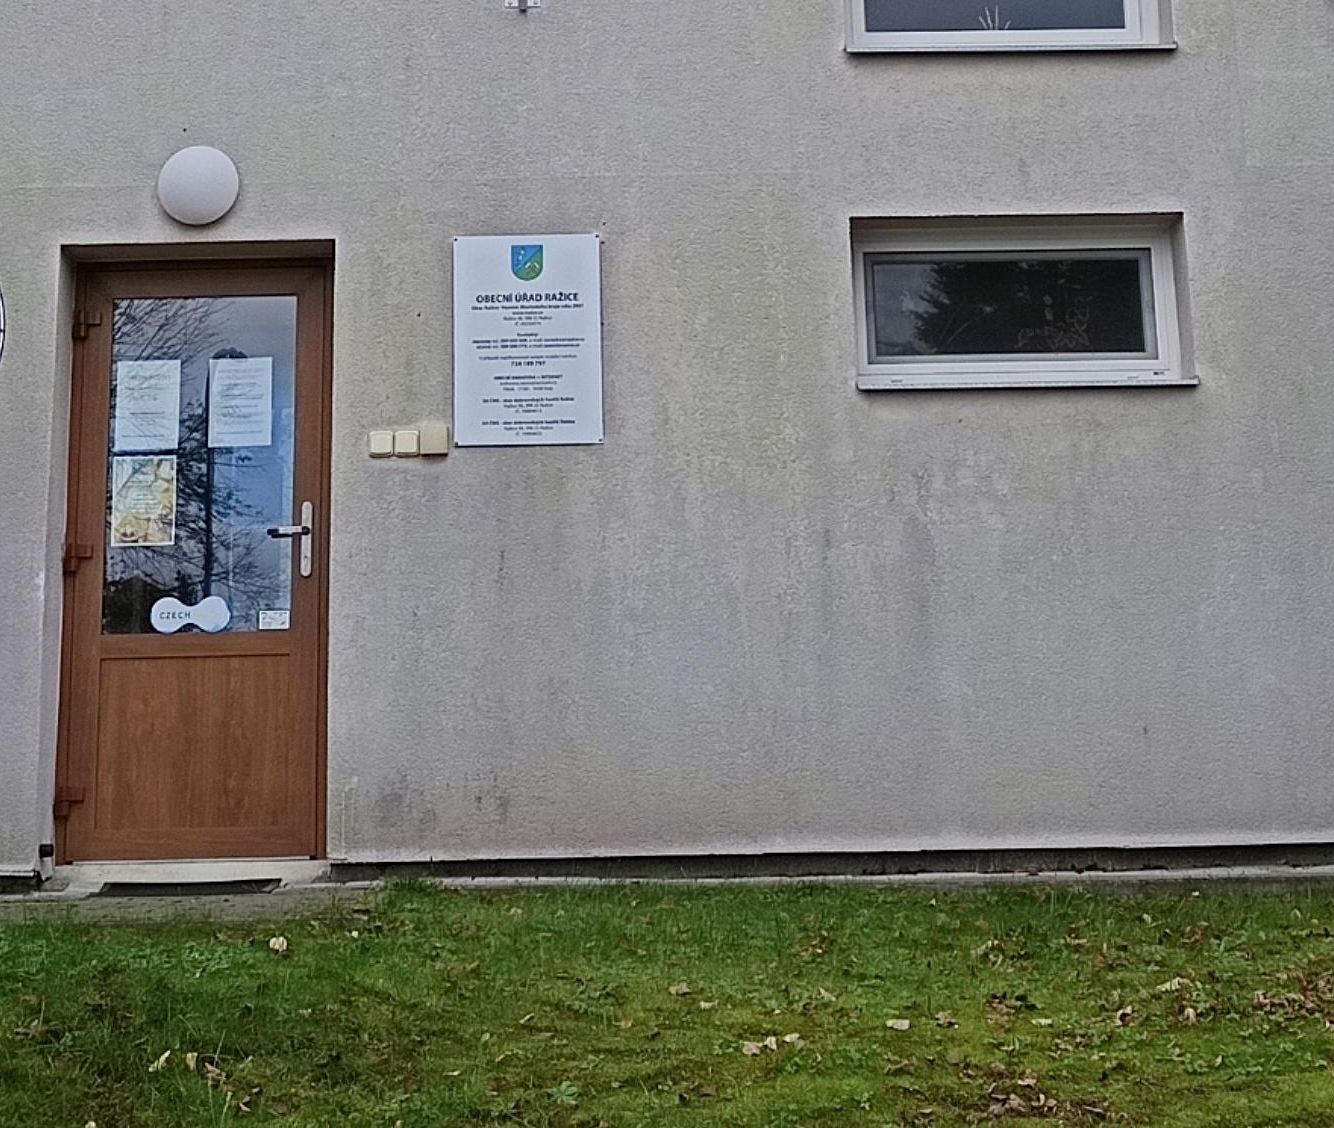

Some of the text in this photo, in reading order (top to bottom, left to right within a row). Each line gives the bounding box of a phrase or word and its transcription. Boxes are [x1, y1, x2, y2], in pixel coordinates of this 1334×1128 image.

[475, 290, 579, 303] OBECNÍ ÚŘAD RAŽICE
[159, 611, 191, 620] CZECH
